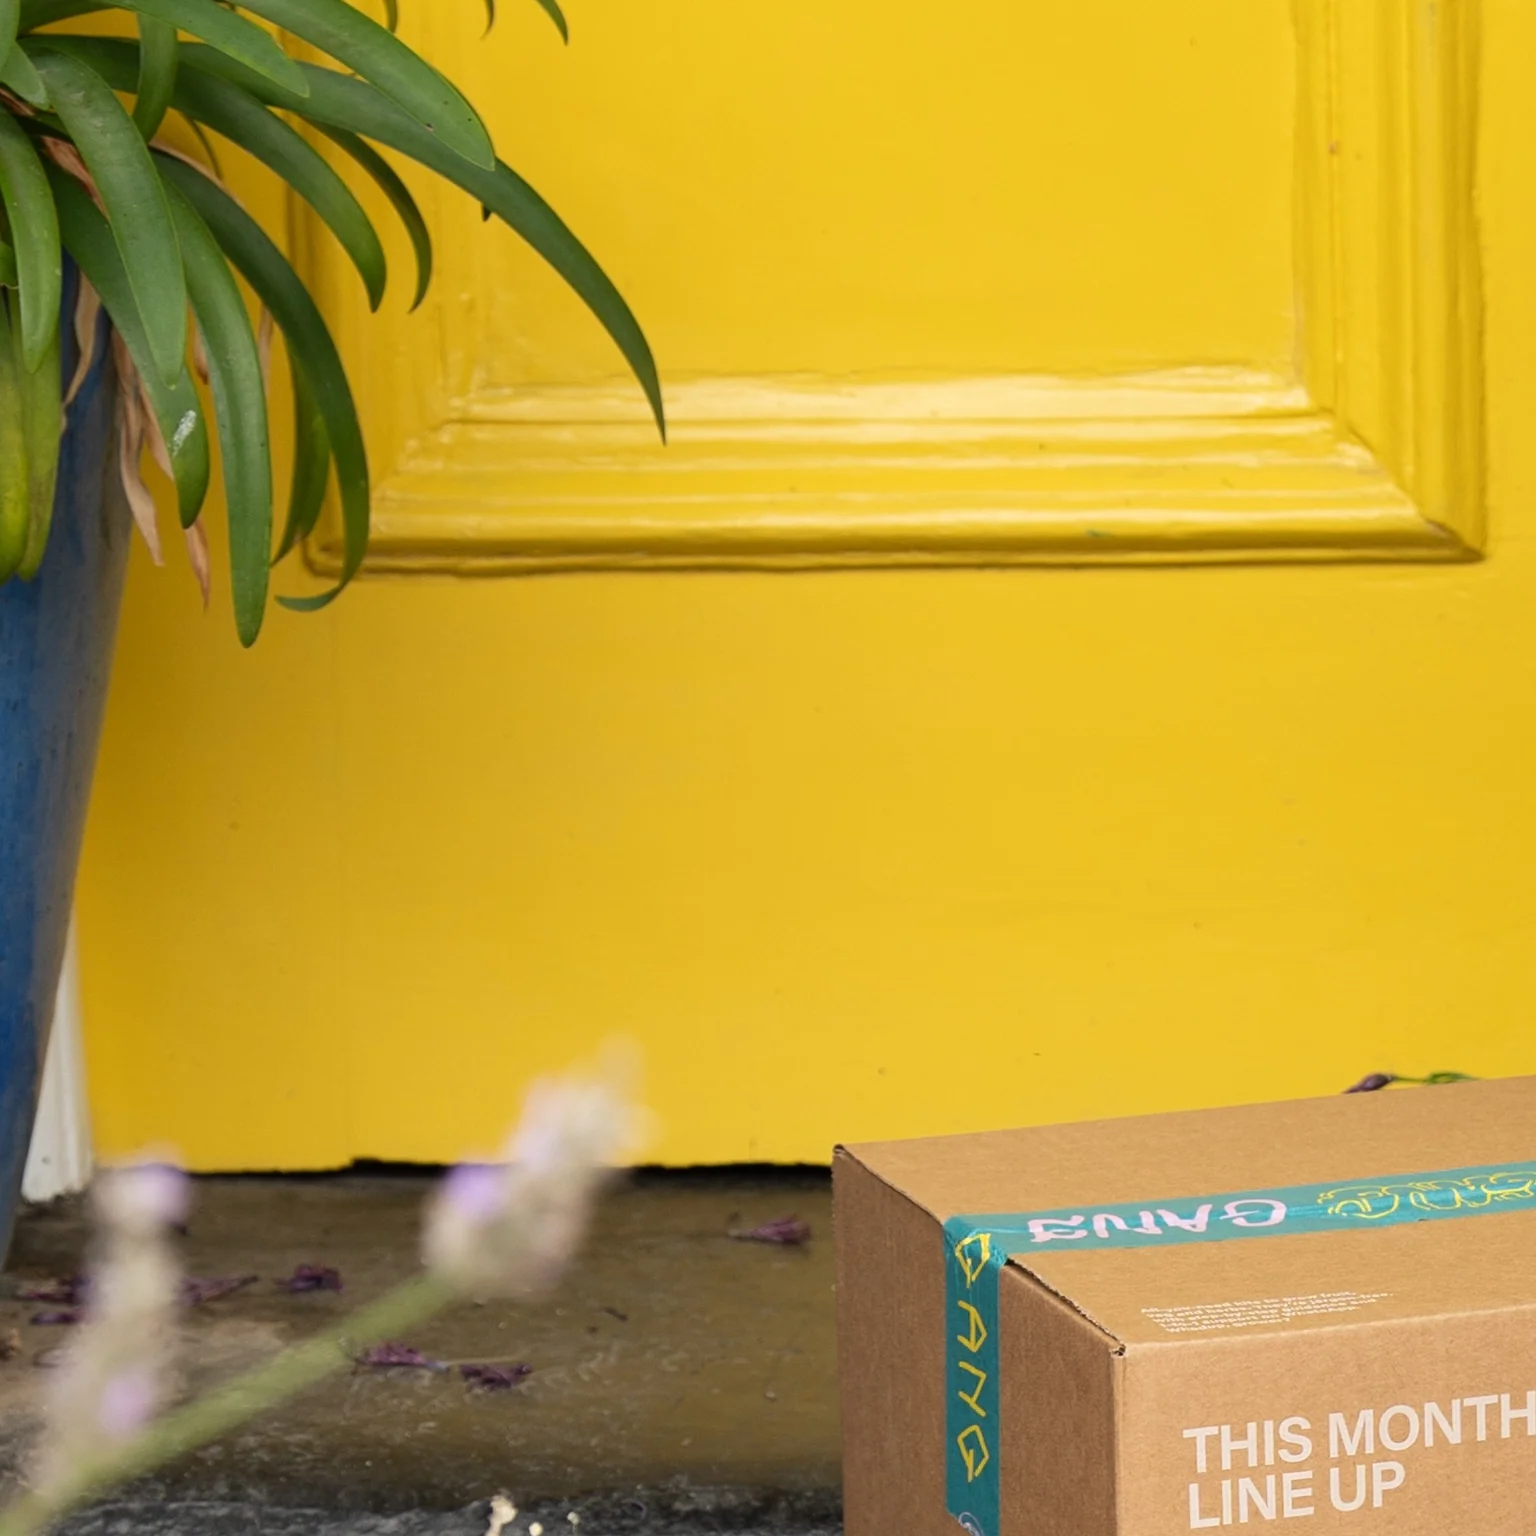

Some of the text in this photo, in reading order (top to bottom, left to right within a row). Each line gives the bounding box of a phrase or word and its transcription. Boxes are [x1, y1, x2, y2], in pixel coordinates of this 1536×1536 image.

[955, 1233, 990, 1483] GANG
[1182, 1416, 1313, 1473] THIS
[1188, 1460, 1406, 1529] LINE UP
